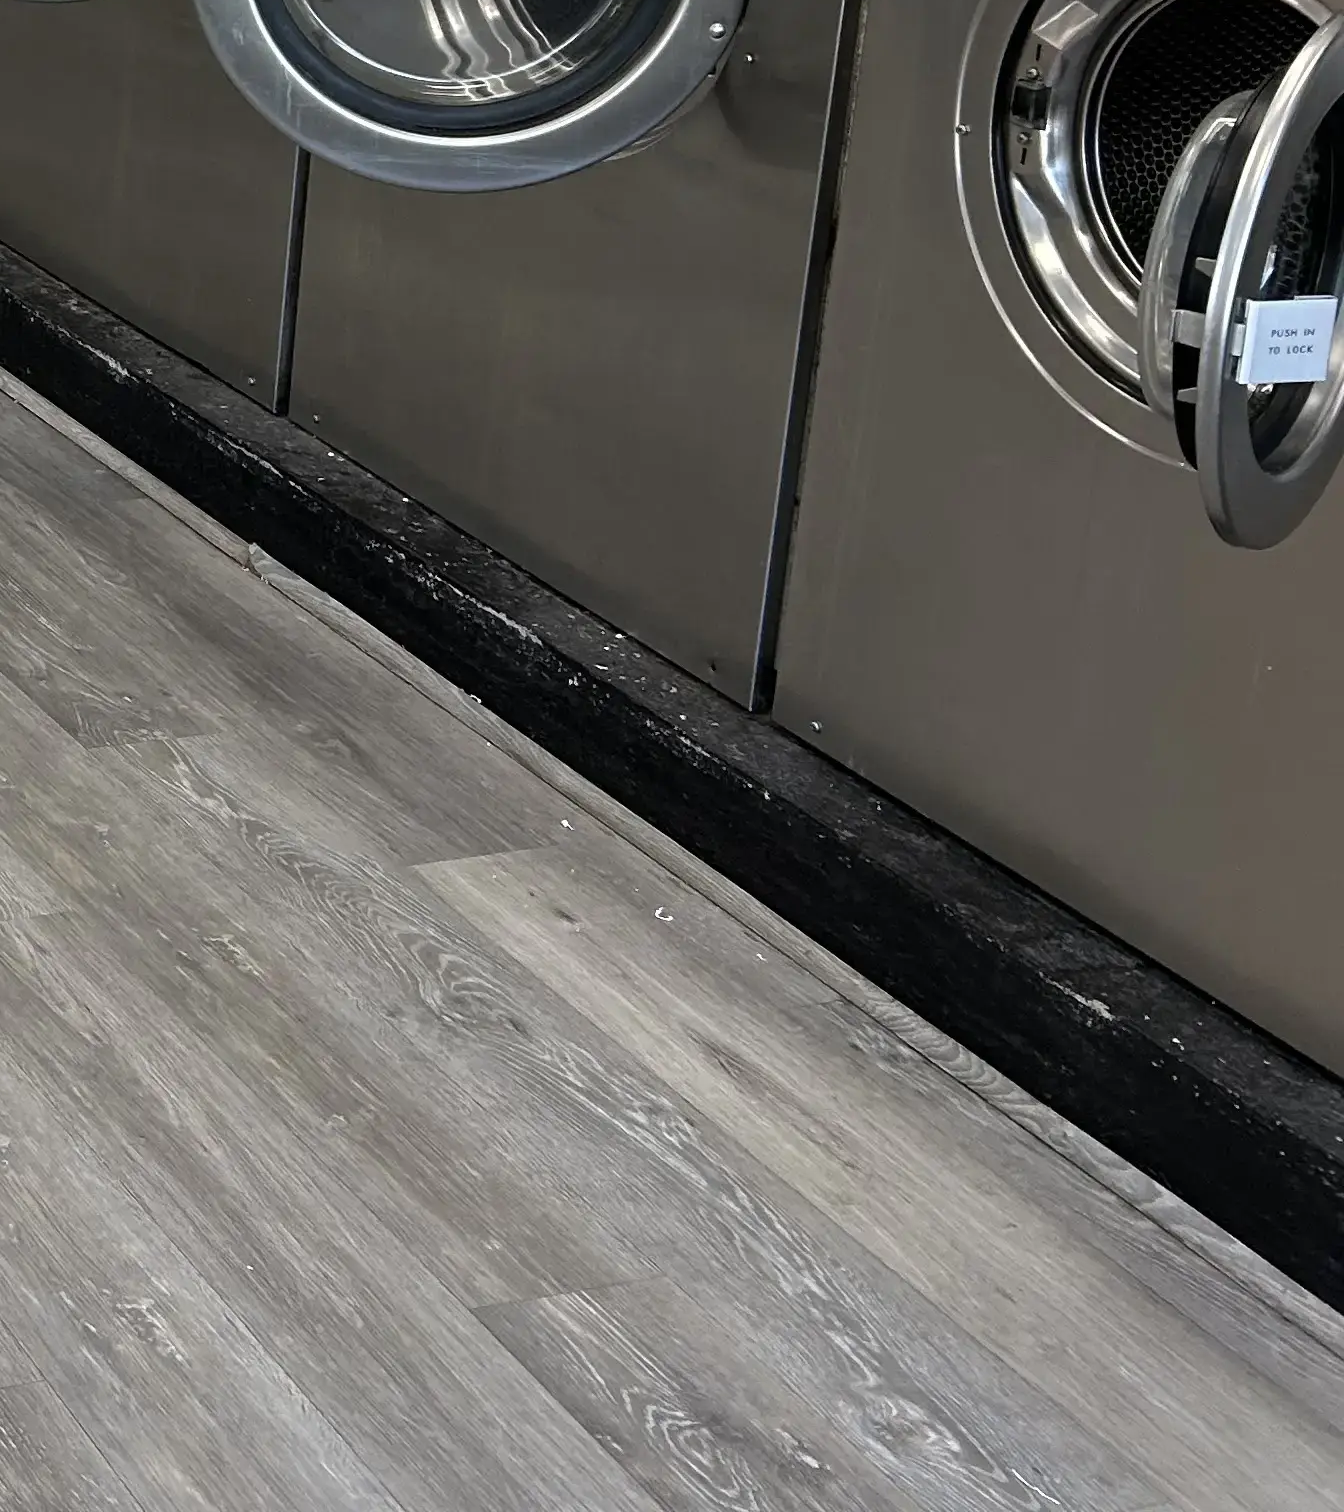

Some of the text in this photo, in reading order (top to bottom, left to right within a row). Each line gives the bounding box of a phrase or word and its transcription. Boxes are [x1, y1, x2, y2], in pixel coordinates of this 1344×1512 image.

[1271, 328, 1316, 338] PUSH IN
[1268, 345, 1313, 355] TO LOCK
